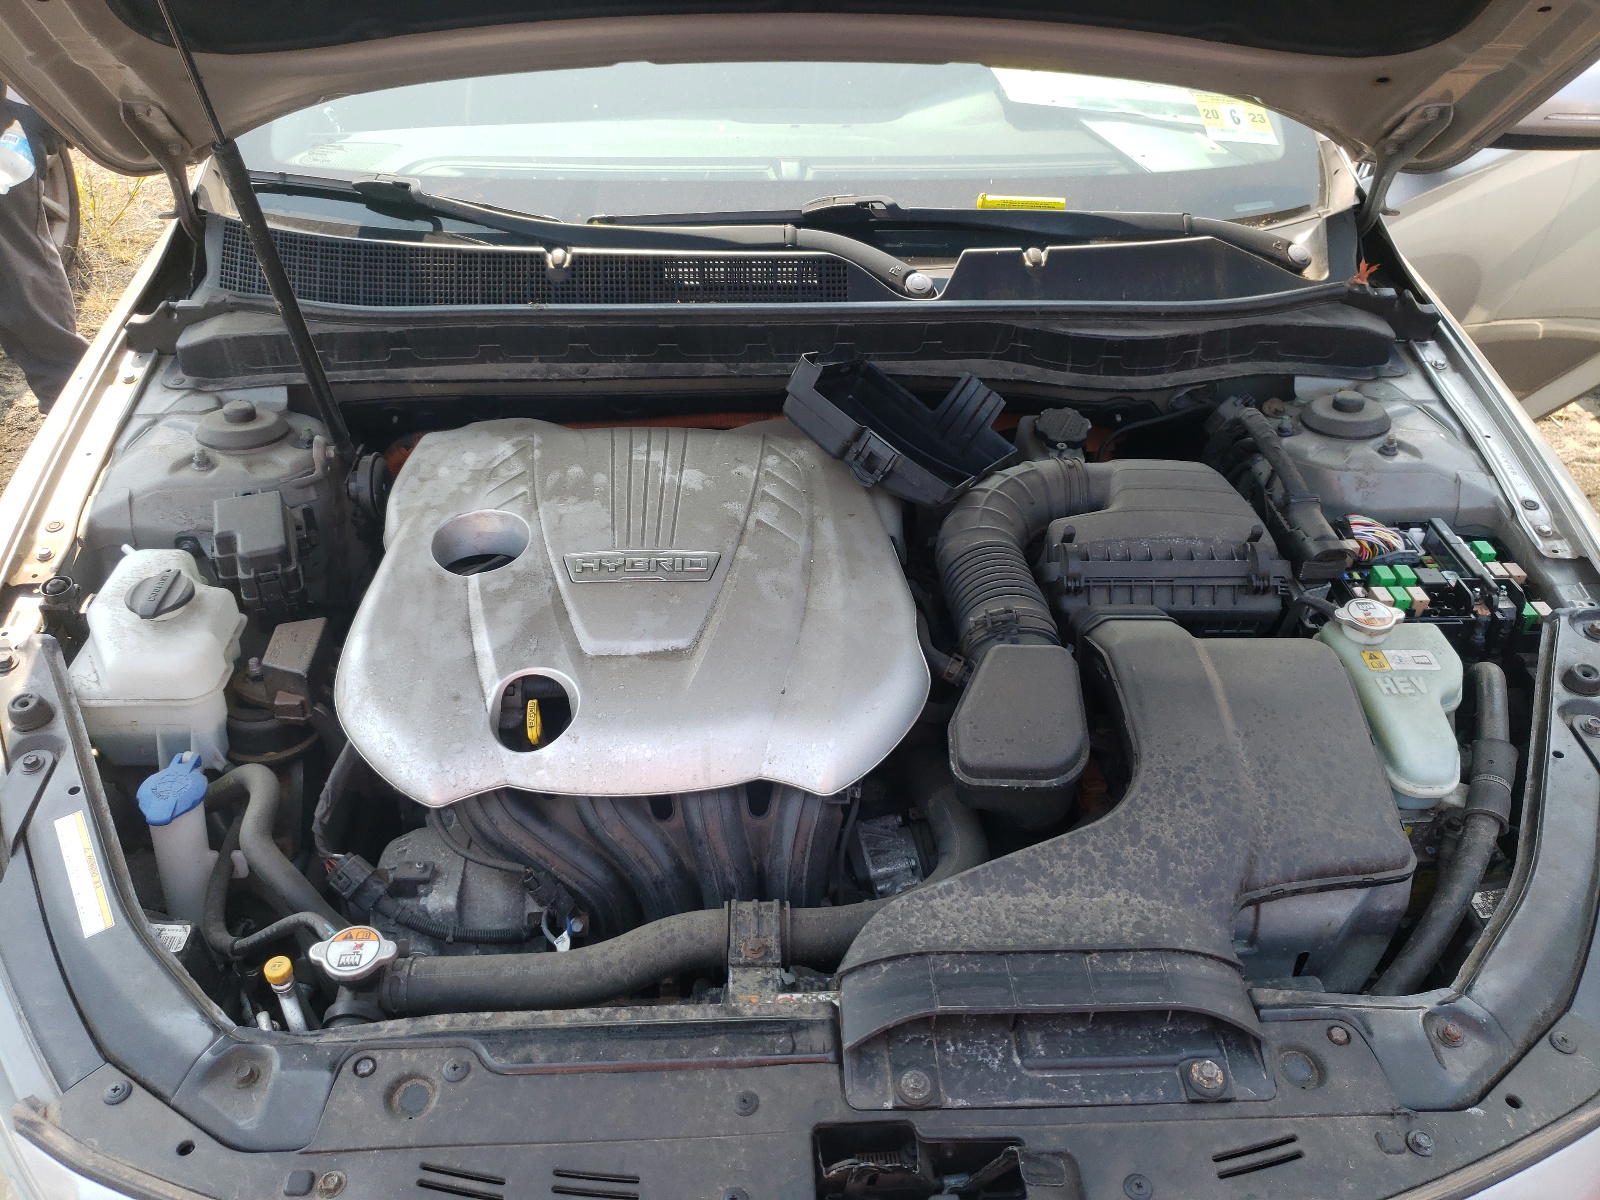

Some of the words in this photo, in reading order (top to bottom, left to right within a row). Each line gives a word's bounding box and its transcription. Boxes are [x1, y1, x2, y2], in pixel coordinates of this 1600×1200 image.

[1203, 108, 1219, 120] 20
[1230, 108, 1241, 125] 6
[1248, 112, 1266, 124] 23
[575, 557, 708, 573] HYBRID
[1375, 676, 1429, 696] HEV
